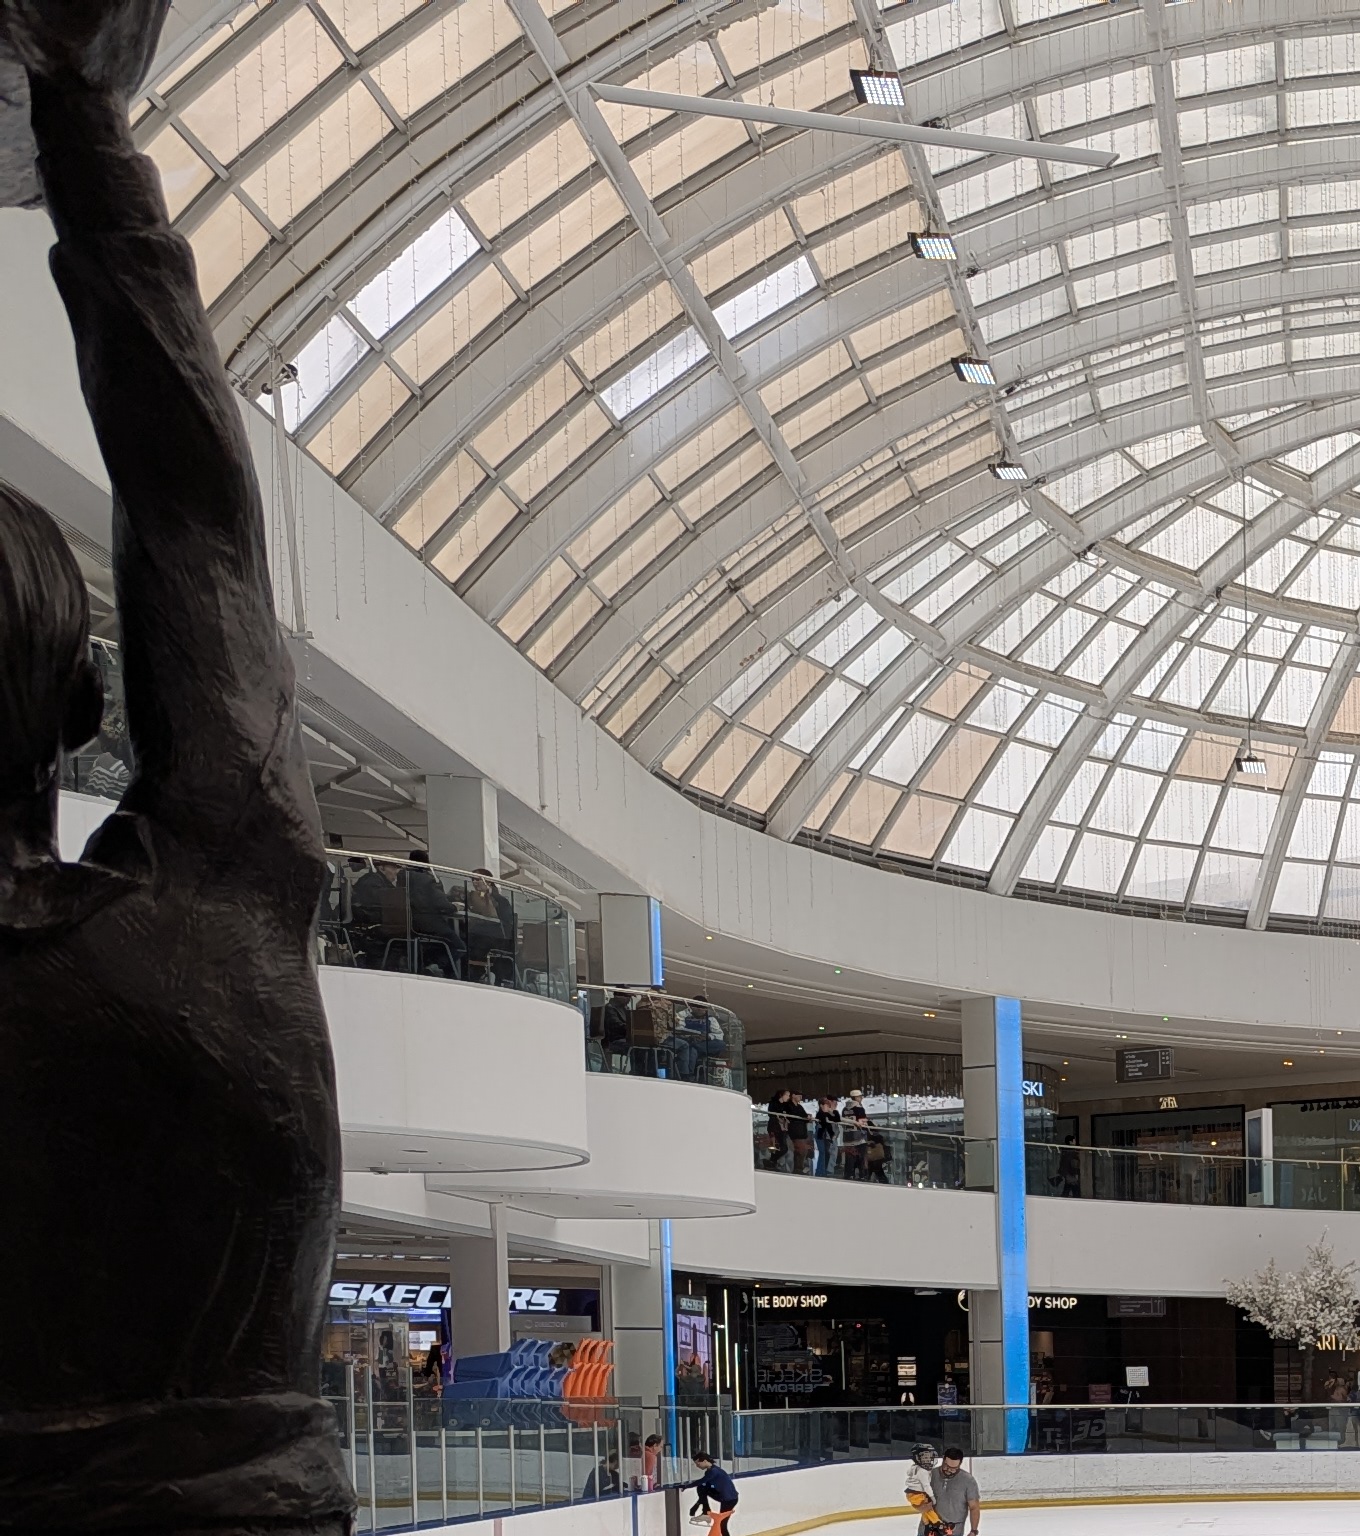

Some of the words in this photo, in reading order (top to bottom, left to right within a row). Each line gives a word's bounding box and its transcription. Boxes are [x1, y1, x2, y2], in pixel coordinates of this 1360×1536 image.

[752, 1295, 770, 1309] THE
[772, 1295, 799, 1308] BODY
[800, 1294, 828, 1308] SHOP
[1044, 1296, 1078, 1310] SHOP
